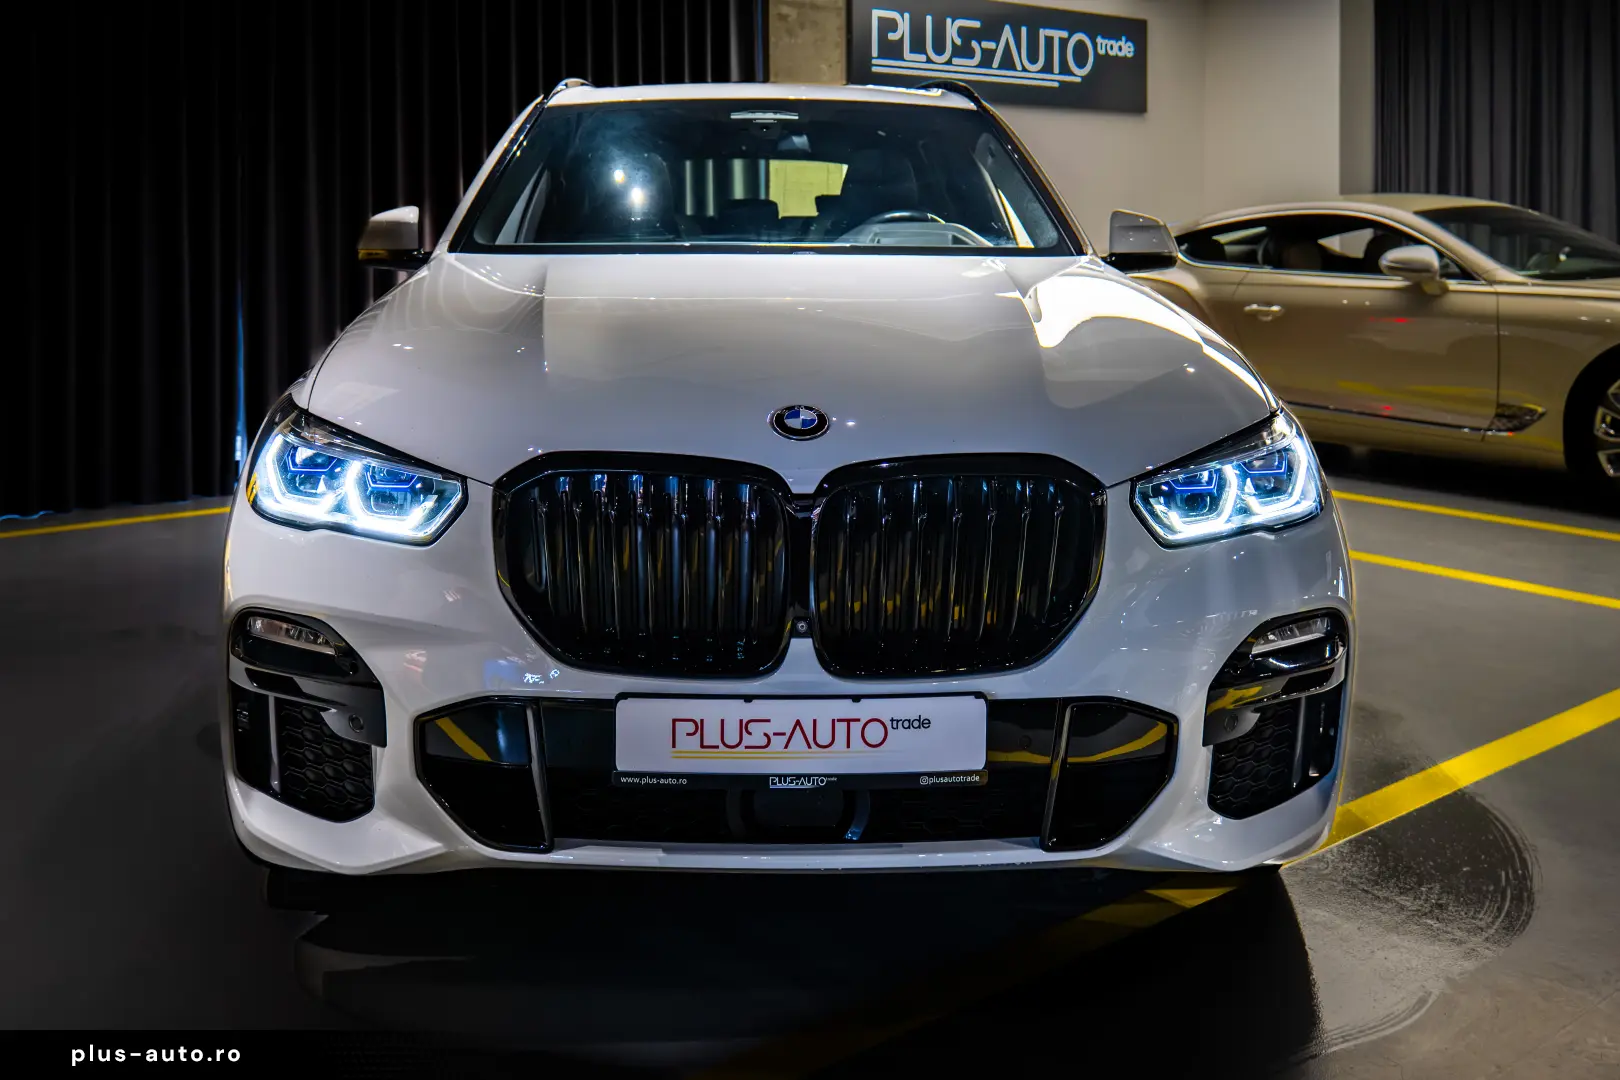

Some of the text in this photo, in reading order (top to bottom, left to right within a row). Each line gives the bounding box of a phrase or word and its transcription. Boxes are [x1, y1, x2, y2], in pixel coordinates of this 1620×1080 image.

[871, 8, 1135, 77] PLUS-AUTO trade
[671, 714, 932, 750] PLUS-AUTO trade
[620, 775, 687, 785] www.plus-auto.ro
[769, 776, 827, 787] PLUS-AUTO
